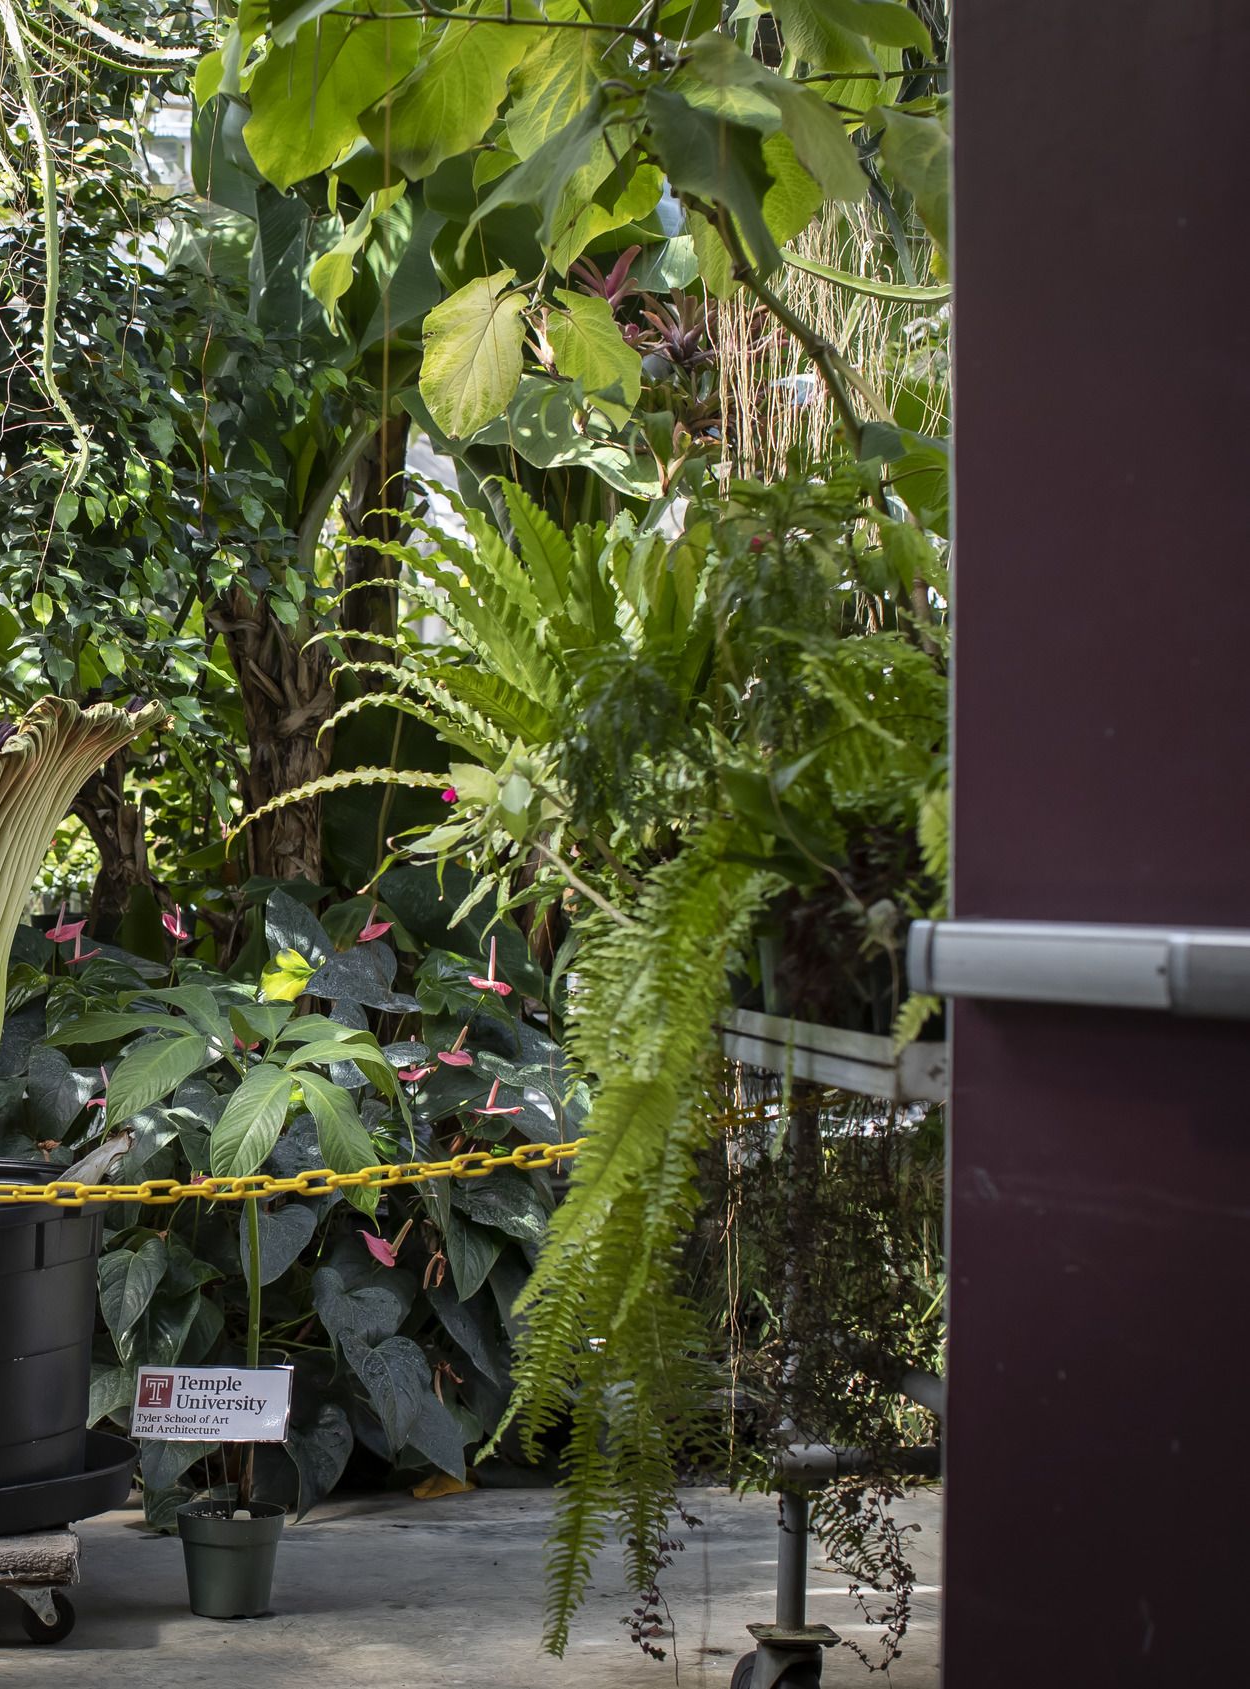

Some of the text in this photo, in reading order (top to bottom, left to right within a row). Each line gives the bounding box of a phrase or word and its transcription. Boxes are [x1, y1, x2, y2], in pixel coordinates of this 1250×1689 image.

[178, 1375, 242, 1396] Temple
[176, 1394, 268, 1416] University
[136, 1413, 230, 1425] Tyler School of Art
[135, 1424, 220, 1435] and Architecture
